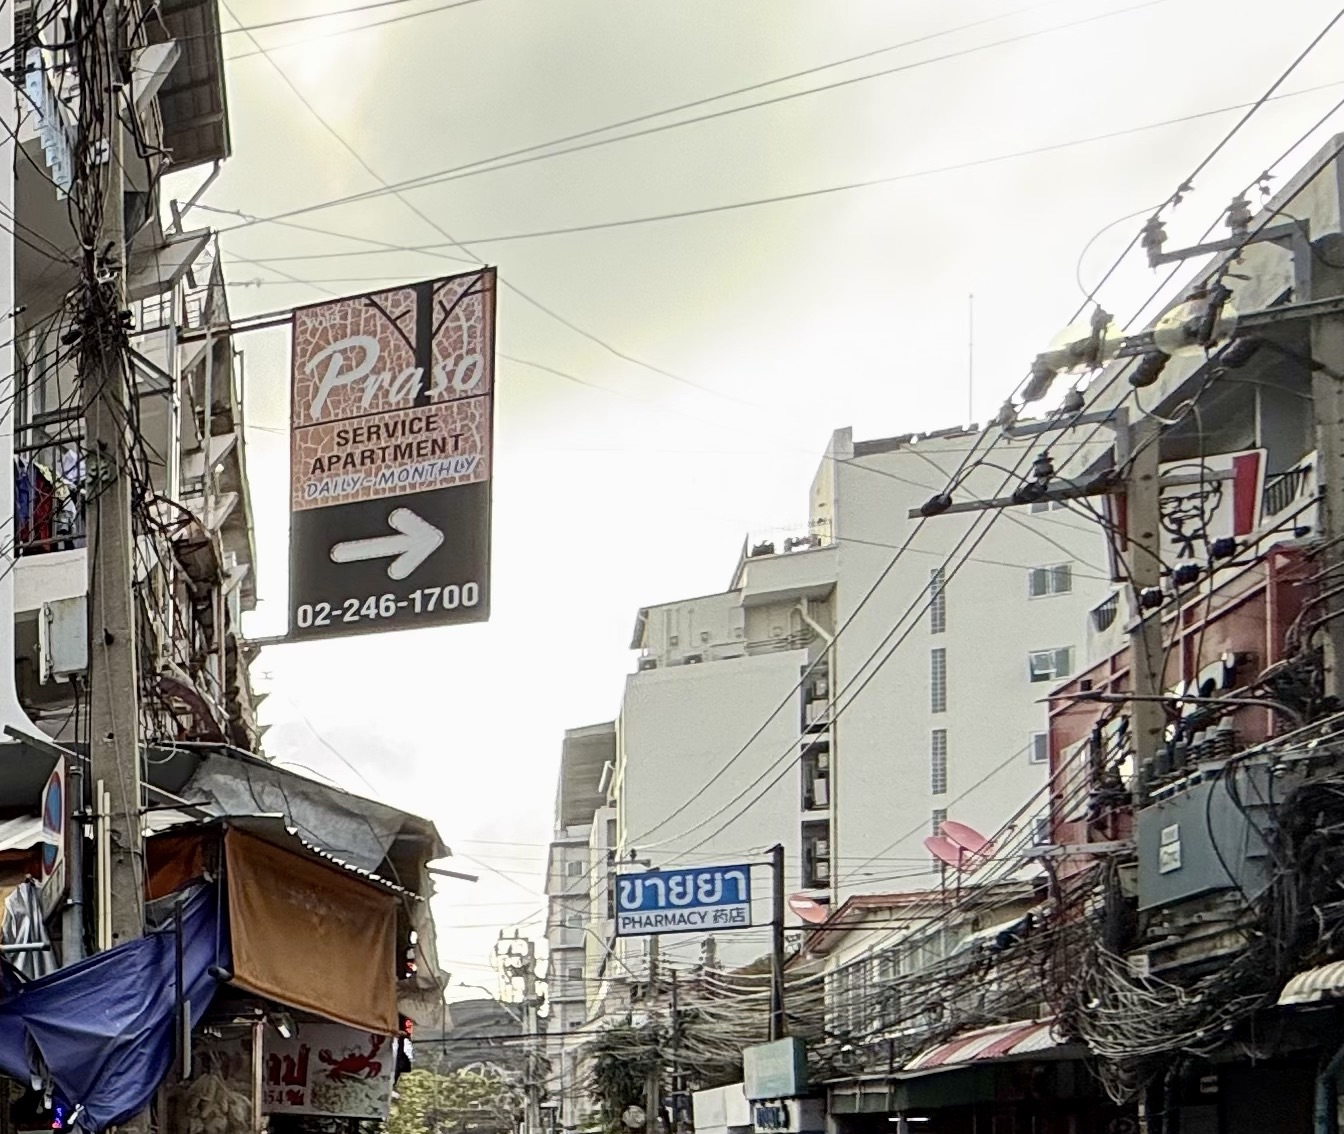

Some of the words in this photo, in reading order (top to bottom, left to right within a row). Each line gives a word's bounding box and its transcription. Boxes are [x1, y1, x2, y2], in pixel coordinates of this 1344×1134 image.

[304, 334, 485, 421] Praso
[335, 413, 439, 448] SERVICE
[310, 432, 464, 475] APARTMENT
[296, 581, 480, 629] 02-246-1700
[619, 869, 748, 910] ขายยา
[621, 909, 709, 930] PHARMACY
